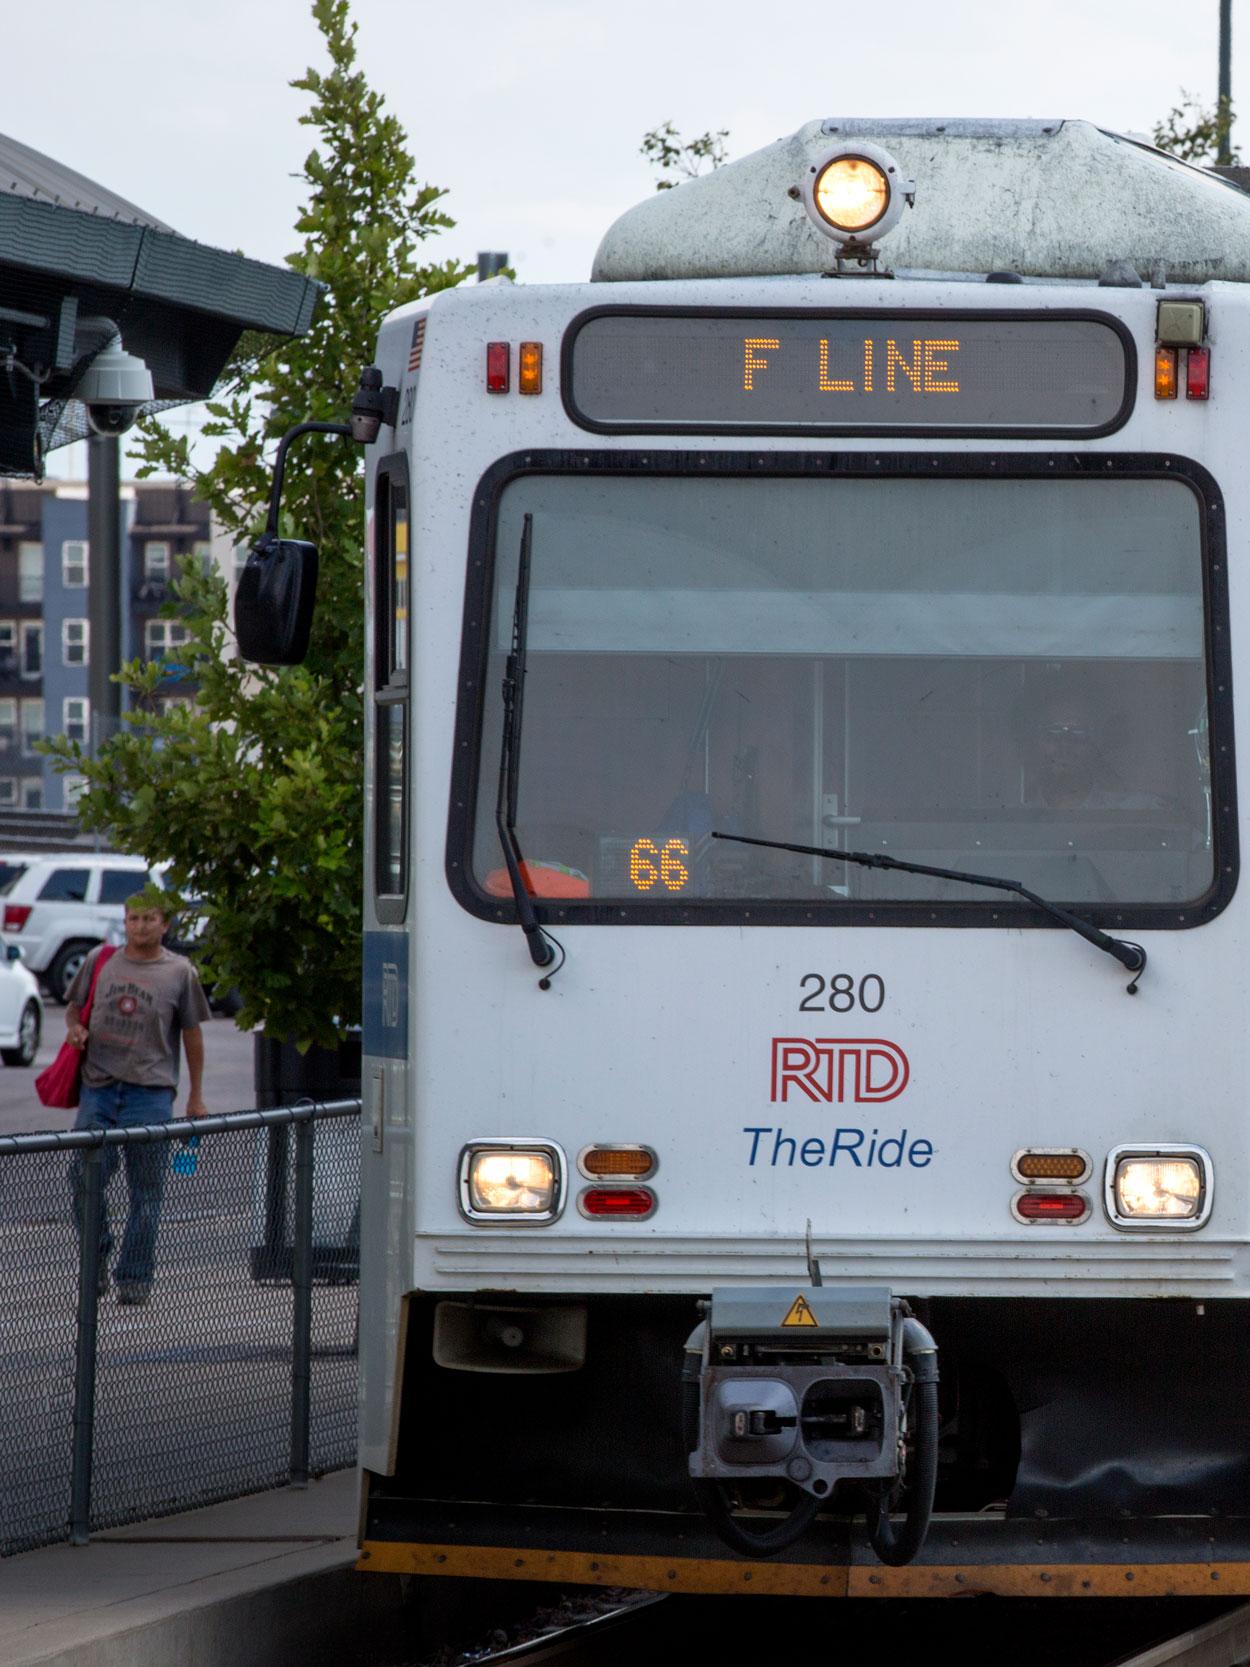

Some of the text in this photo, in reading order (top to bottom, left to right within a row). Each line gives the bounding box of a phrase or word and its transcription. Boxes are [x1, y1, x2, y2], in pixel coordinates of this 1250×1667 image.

[744, 338, 960, 392] F LINE
[630, 838, 689, 890] 66
[799, 973, 885, 1013] 280
[770, 1037, 910, 1103] RTD
[743, 1127, 933, 1168] TheRide
